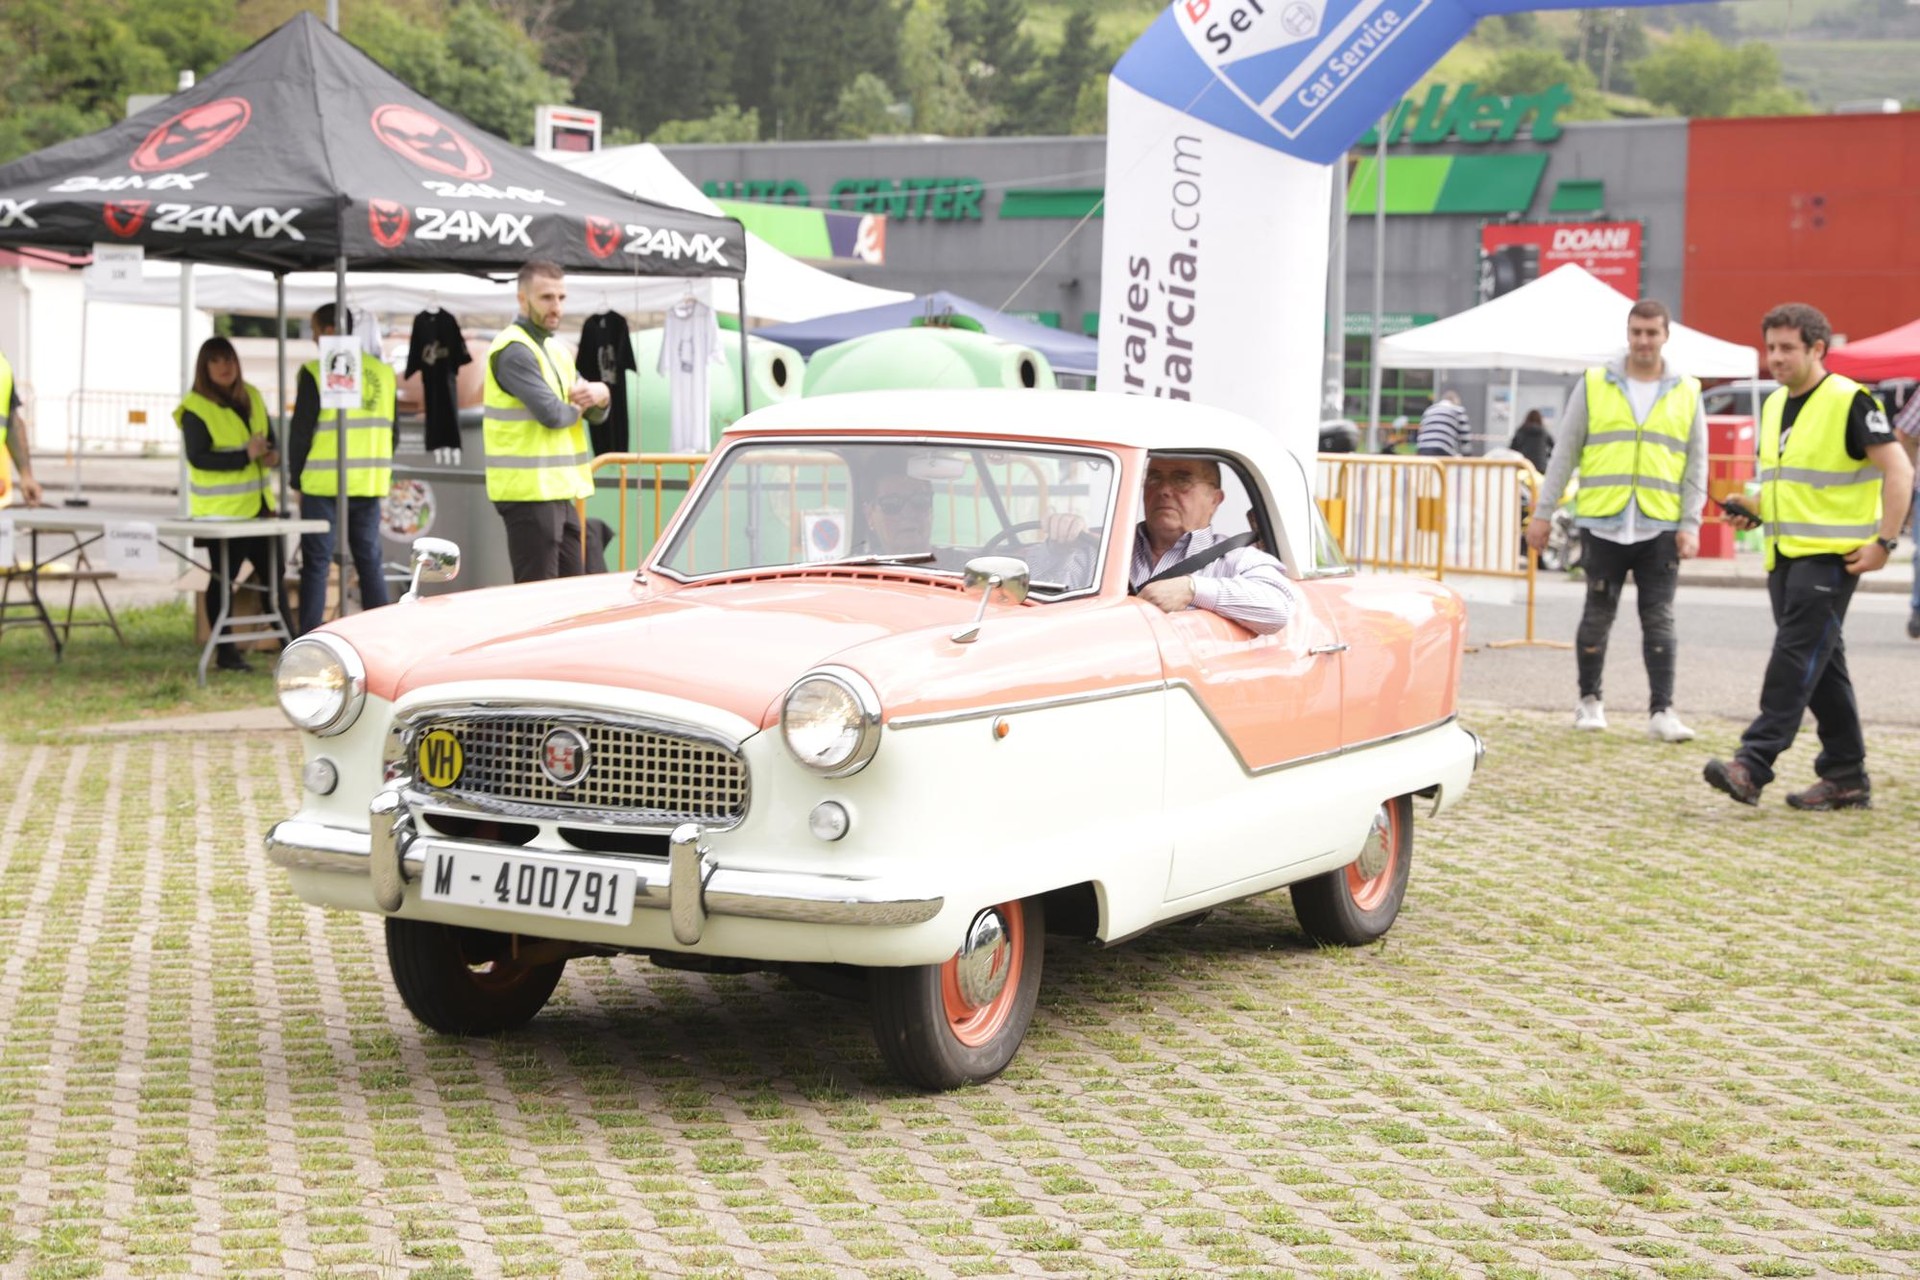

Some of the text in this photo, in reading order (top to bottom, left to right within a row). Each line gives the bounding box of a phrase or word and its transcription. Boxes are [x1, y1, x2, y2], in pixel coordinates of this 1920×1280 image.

[1297, 9, 1401, 108] Car Service
[829, 176, 985, 220] CENTER
[152, 203, 305, 241] 24MX
[414, 207, 533, 247] 24MX
[623, 224, 729, 266] 24MX
[1120, 255, 1156, 394] rajes
[426, 737, 455, 780] VH
